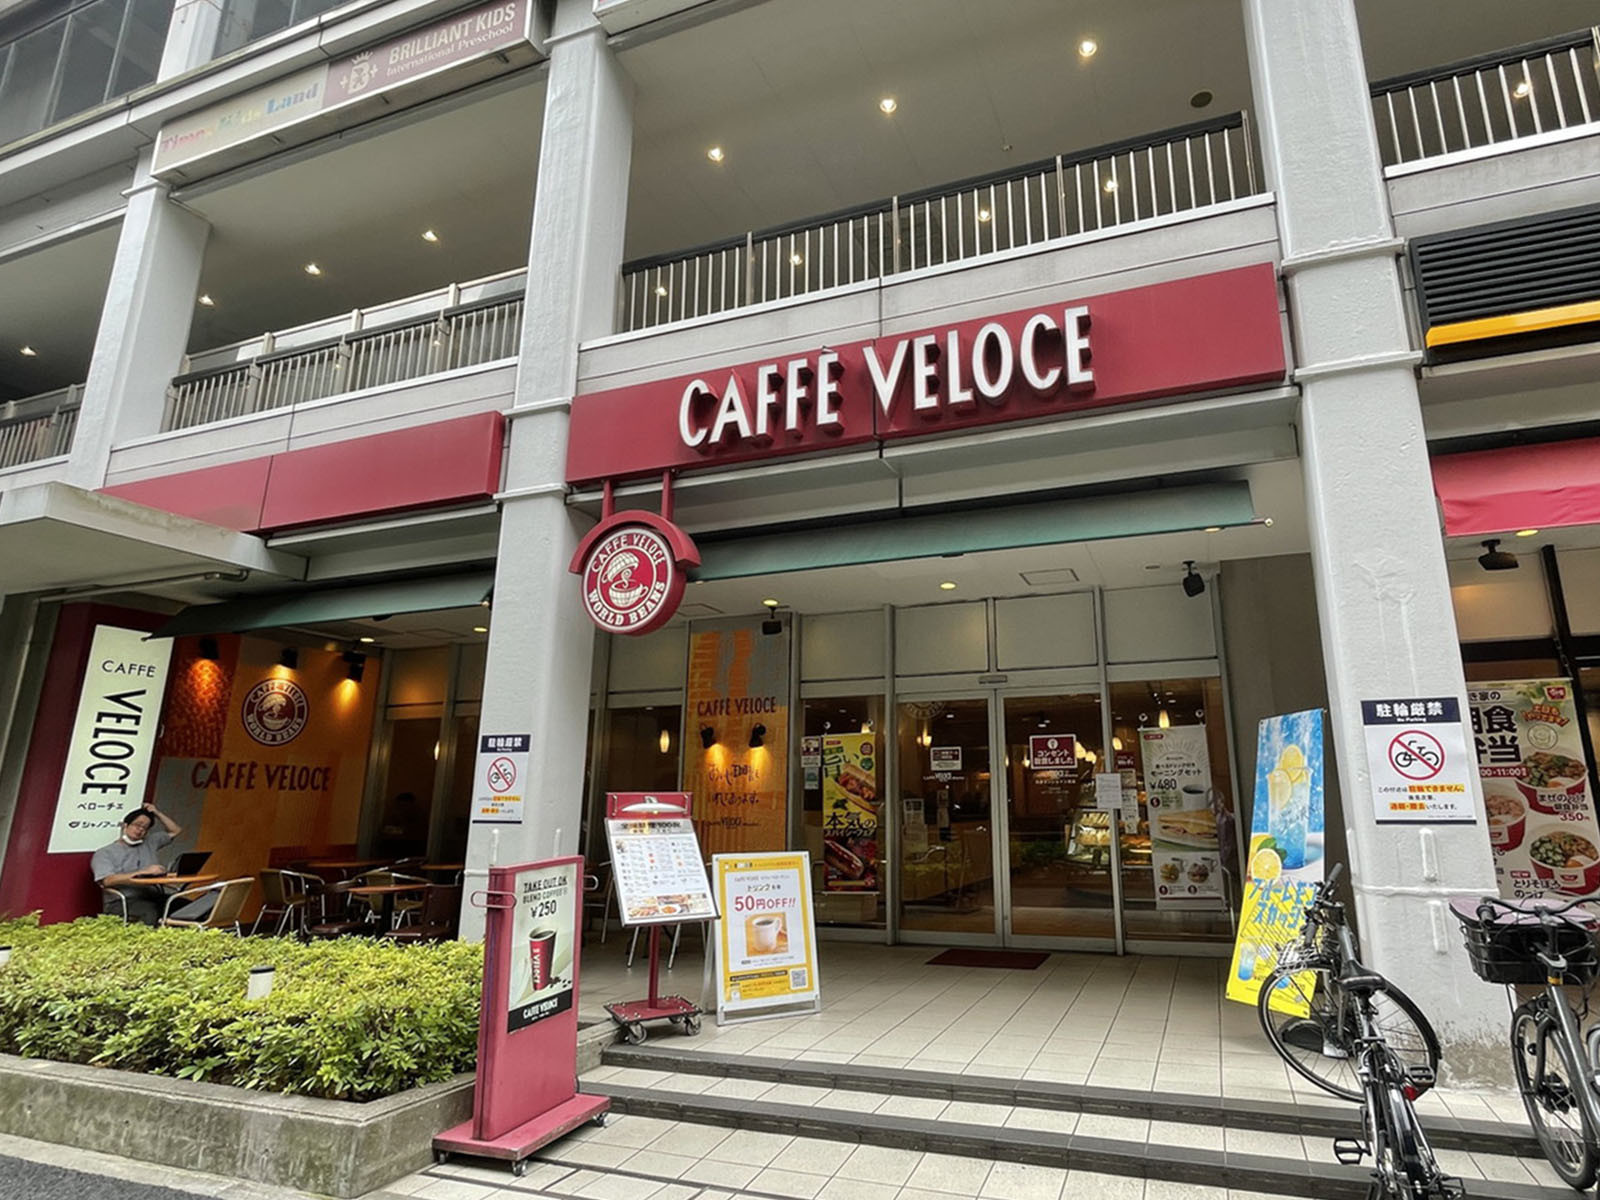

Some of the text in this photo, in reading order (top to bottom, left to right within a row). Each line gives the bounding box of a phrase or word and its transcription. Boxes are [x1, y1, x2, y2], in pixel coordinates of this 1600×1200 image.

[389, 3, 516, 65] BRILLIANT KIDS
[386, 23, 514, 76] International Preschool
[267, 83, 319, 114] Land
[863, 305, 1094, 416] VELOCE
[632, 534, 666, 565] VELOCE
[588, 581, 665, 625] WORLD BEANS
[735, 696, 776, 714] VELOCE
[1376, 701, 1443, 717] 駐輪厳禁
[80, 689, 146, 795] VELOCE
[264, 764, 331, 791] VELOCE
[1150, 779, 1177, 790] ¥480
[77, 802, 123, 811] ベローチェ
[825, 811, 875, 830] 本気の
[524, 880, 541, 893] TAKE
[543, 877, 557, 889] OUT
[531, 900, 557, 918] ¥250
[735, 895, 796, 911] 50円OFF!!
